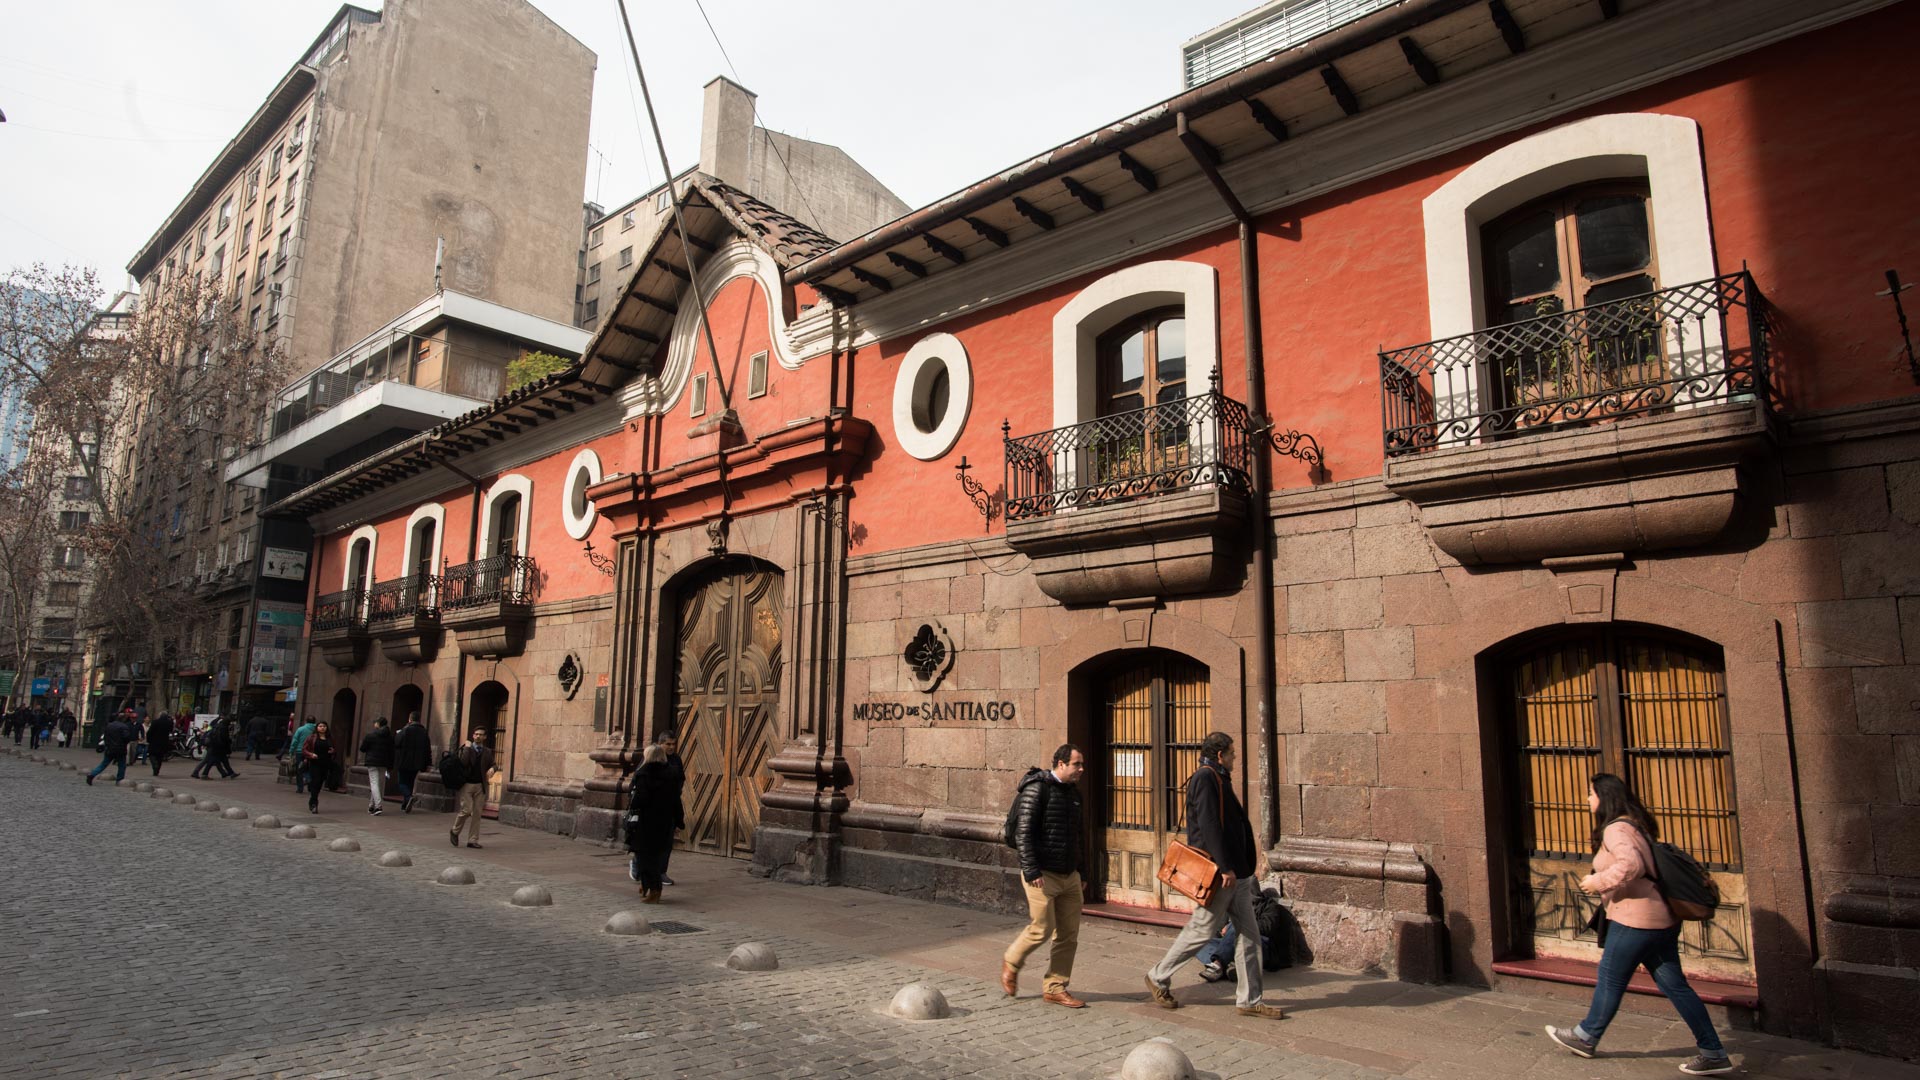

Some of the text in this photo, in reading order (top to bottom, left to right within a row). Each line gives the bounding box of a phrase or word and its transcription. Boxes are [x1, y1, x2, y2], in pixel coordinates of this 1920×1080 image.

[853, 701, 1016, 721] MUSEO DE SANTIAGO
